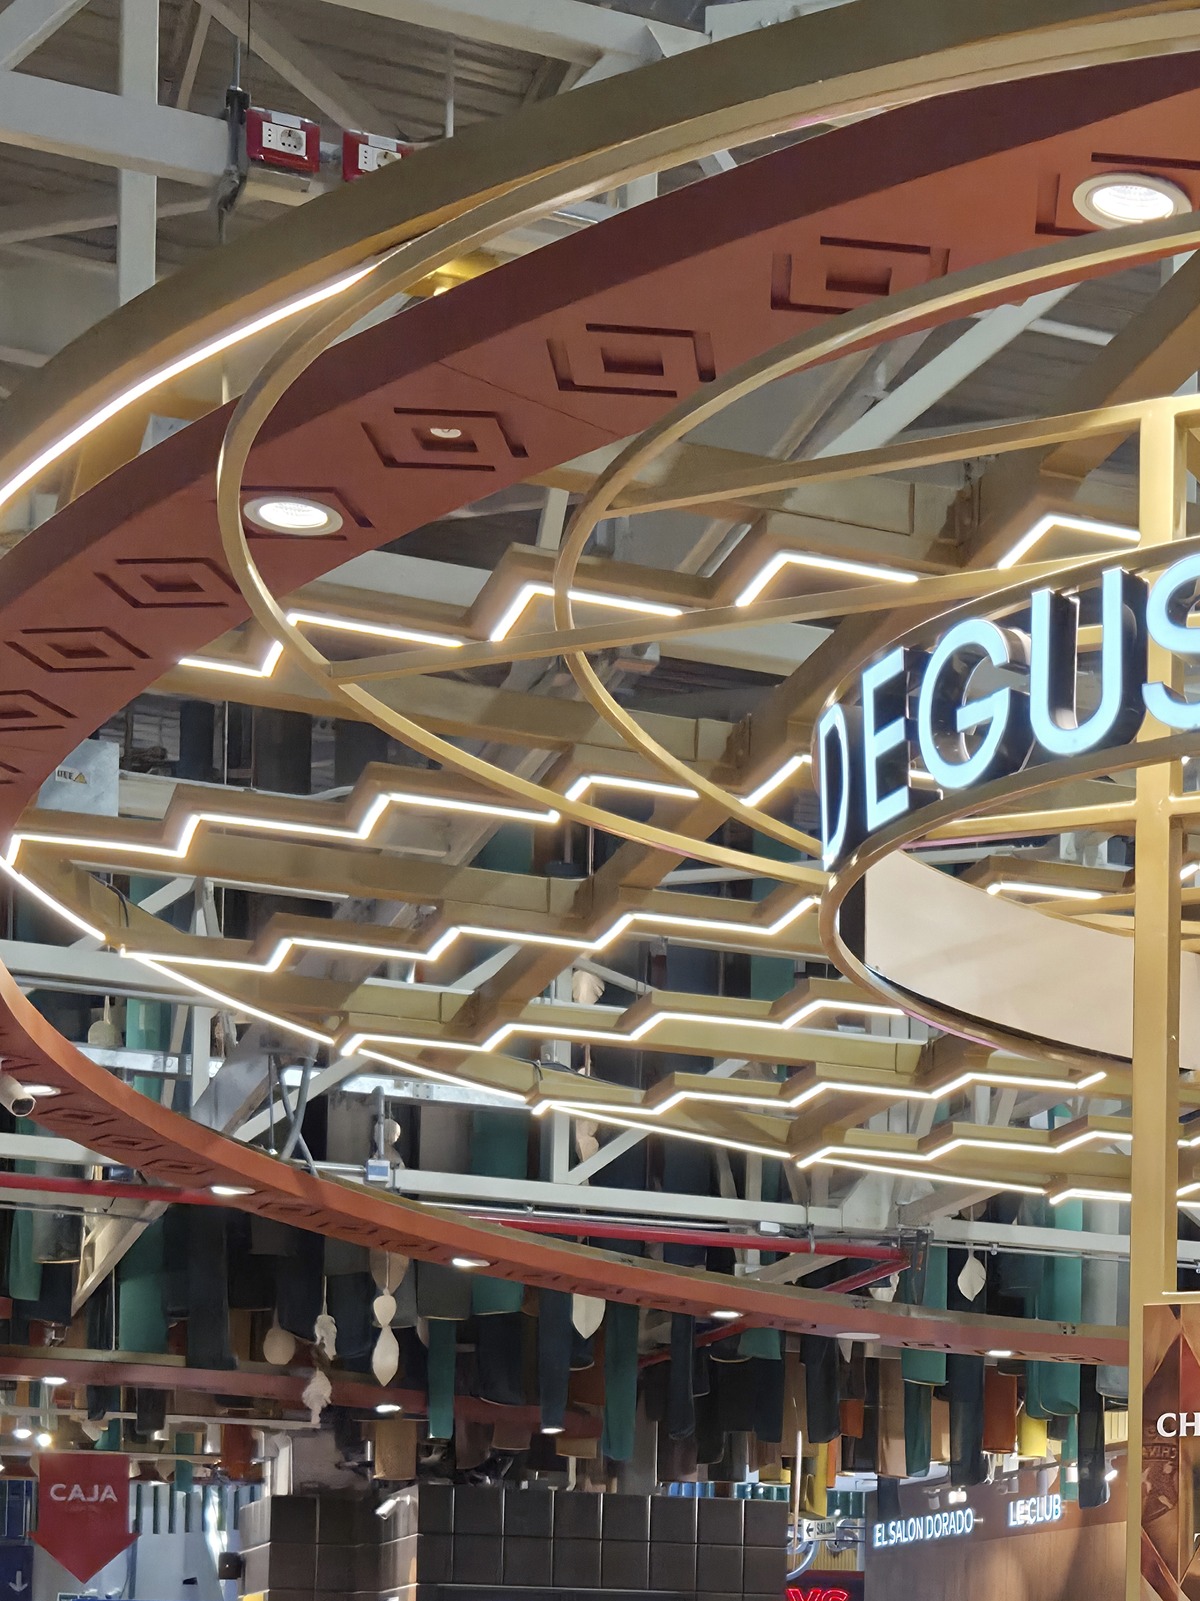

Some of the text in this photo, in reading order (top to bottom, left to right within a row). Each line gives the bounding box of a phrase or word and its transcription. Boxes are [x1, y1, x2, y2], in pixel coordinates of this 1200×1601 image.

[50, 1483, 118, 1502] CAJA
[1008, 1494, 1062, 1527] LE CLUB
[874, 1508, 975, 1548] EL SALON DORADO
